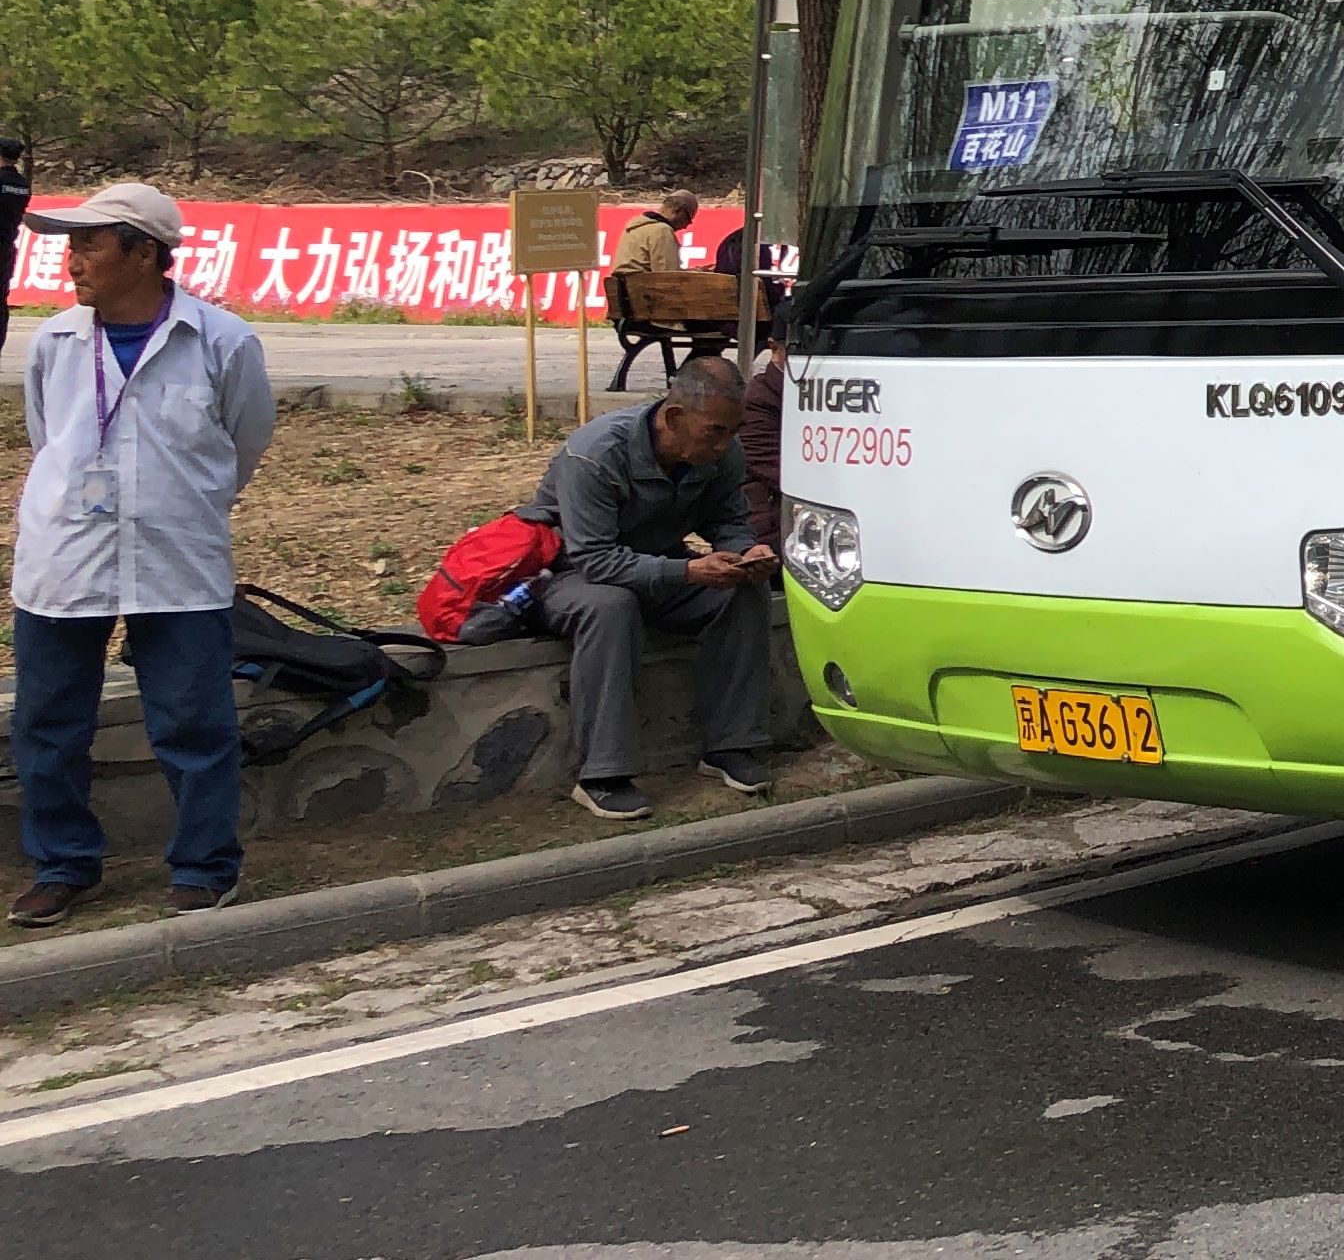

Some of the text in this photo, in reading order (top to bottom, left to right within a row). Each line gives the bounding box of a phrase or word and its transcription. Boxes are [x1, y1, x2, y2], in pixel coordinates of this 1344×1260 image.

[978, 90, 1036, 122] M11
[960, 129, 1027, 163] 百花山
[798, 377, 881, 414] HIGER
[802, 425, 912, 466] 8372905
